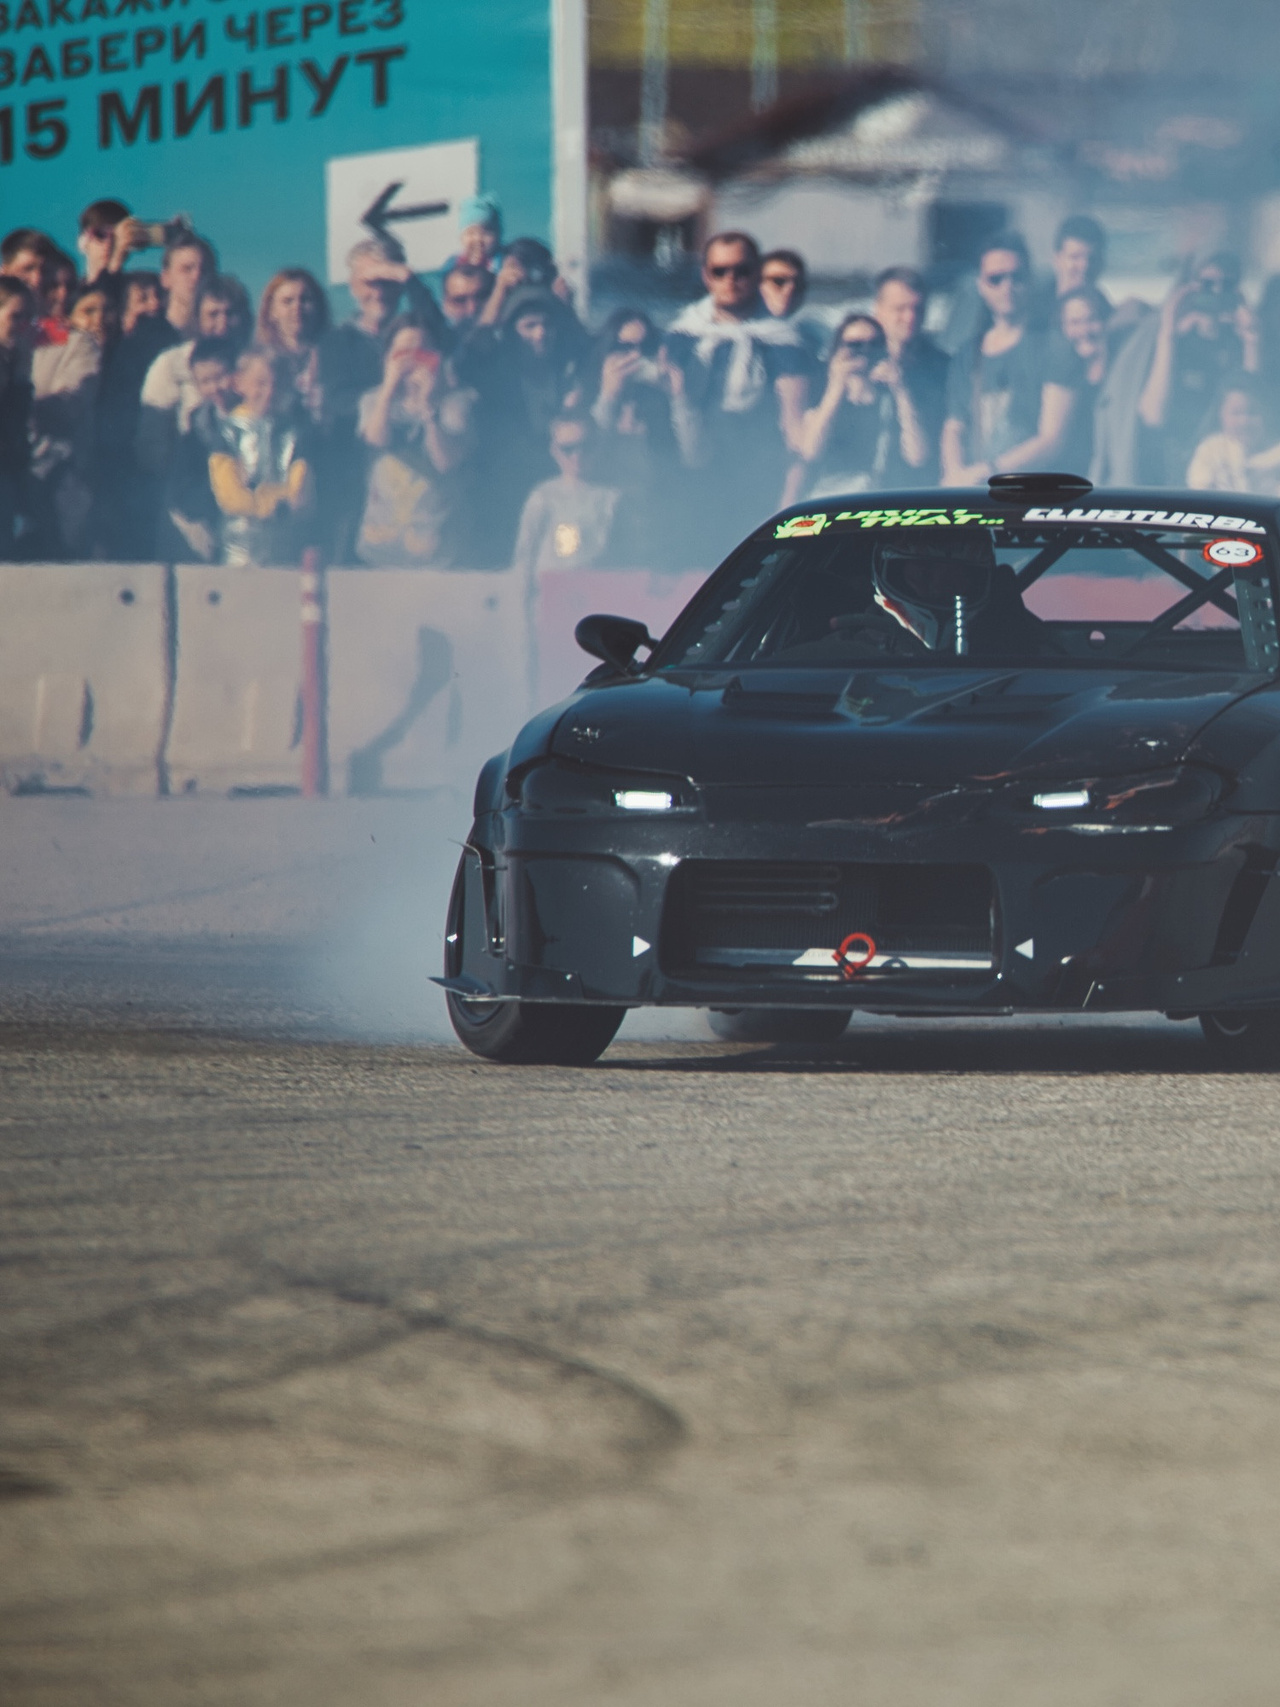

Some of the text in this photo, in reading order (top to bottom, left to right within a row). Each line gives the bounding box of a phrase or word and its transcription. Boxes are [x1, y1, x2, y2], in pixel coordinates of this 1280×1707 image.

[0, 0, 190, 33] АКАЖ
[0, 0, 405, 88] ЗАБЕРИ ЧЕРЕЗ
[0, 46, 407, 166] 15 МИНУТ
[1215, 546, 1250, 557] 63
